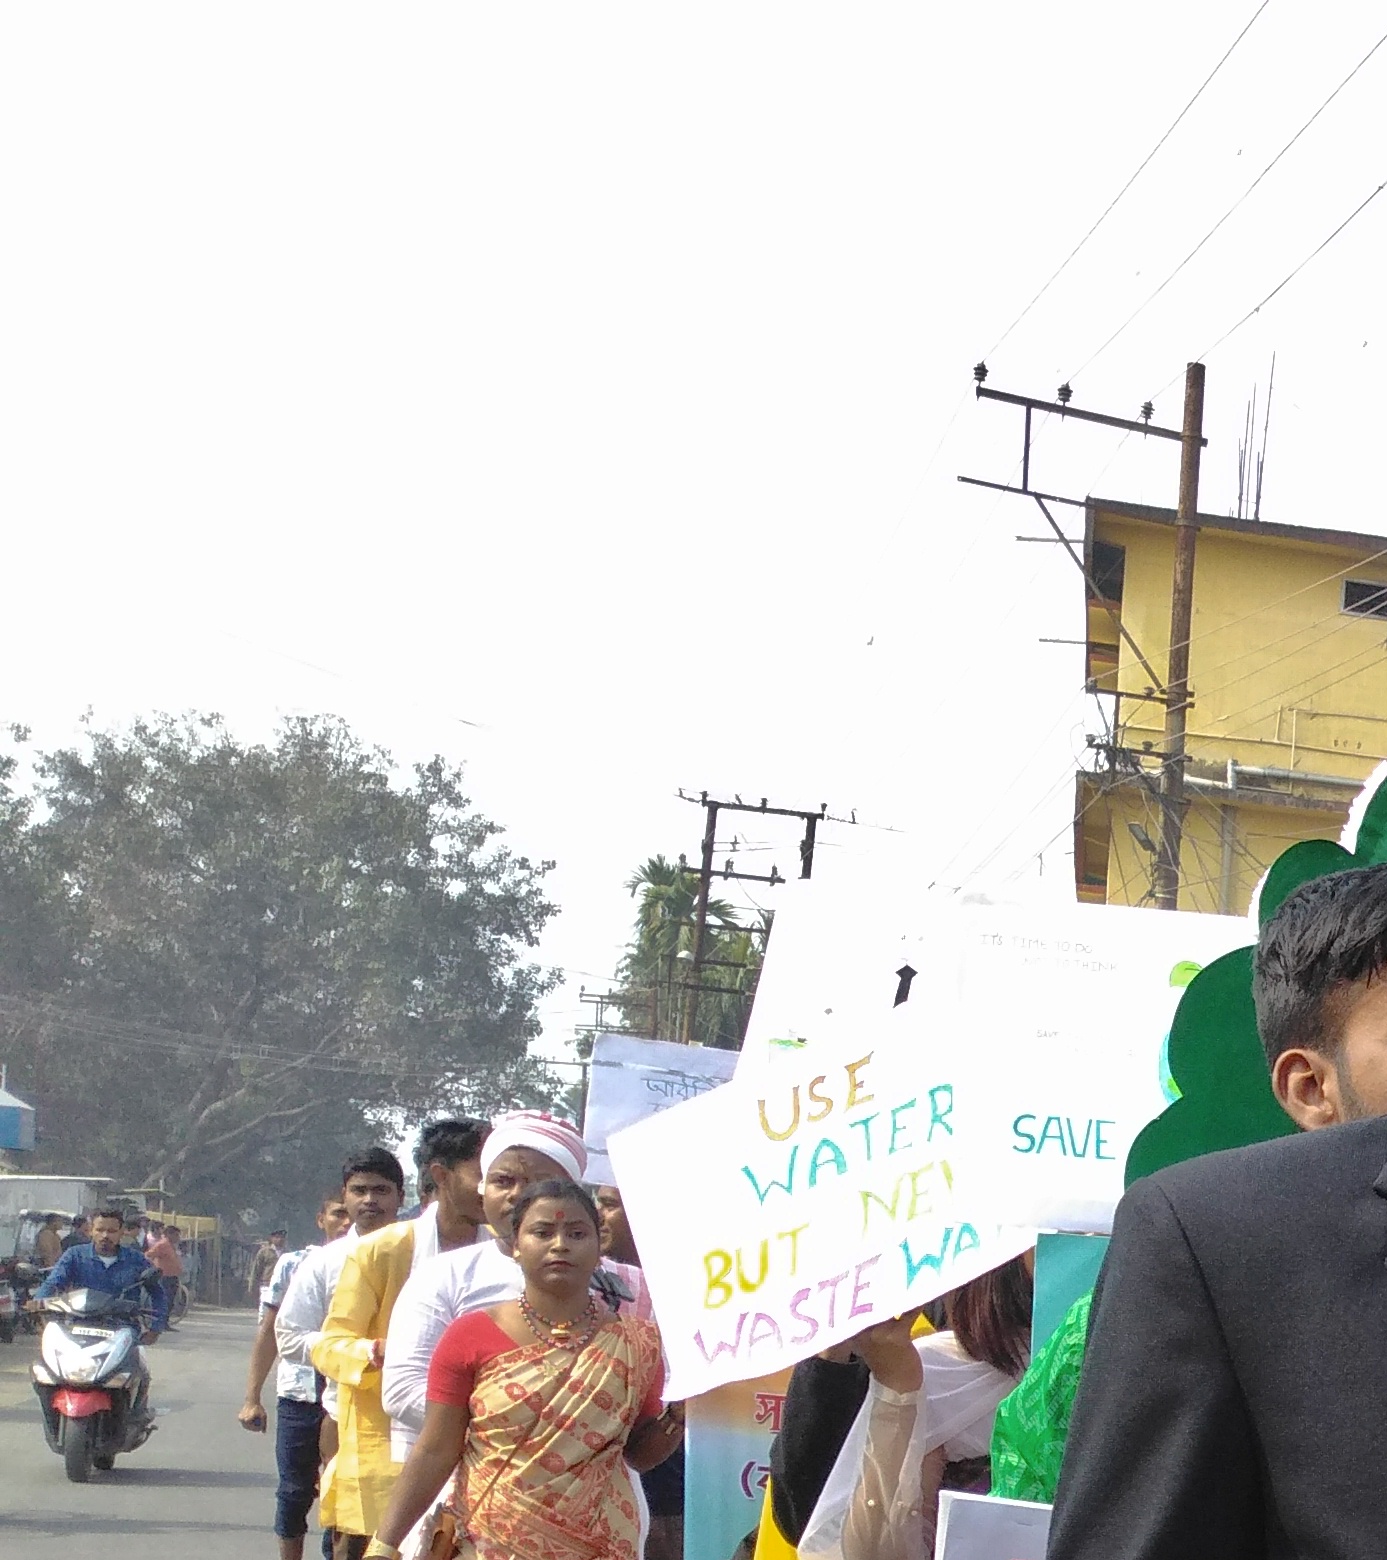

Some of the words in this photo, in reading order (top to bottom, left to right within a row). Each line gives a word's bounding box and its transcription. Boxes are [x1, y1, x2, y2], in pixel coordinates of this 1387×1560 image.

[757, 1051, 875, 1141] USE
[1012, 1113, 1116, 1161] SAVE
[741, 1084, 953, 1206] WATER
[693, 1253, 883, 1364] WASTE
[703, 1222, 810, 1310] BUT
